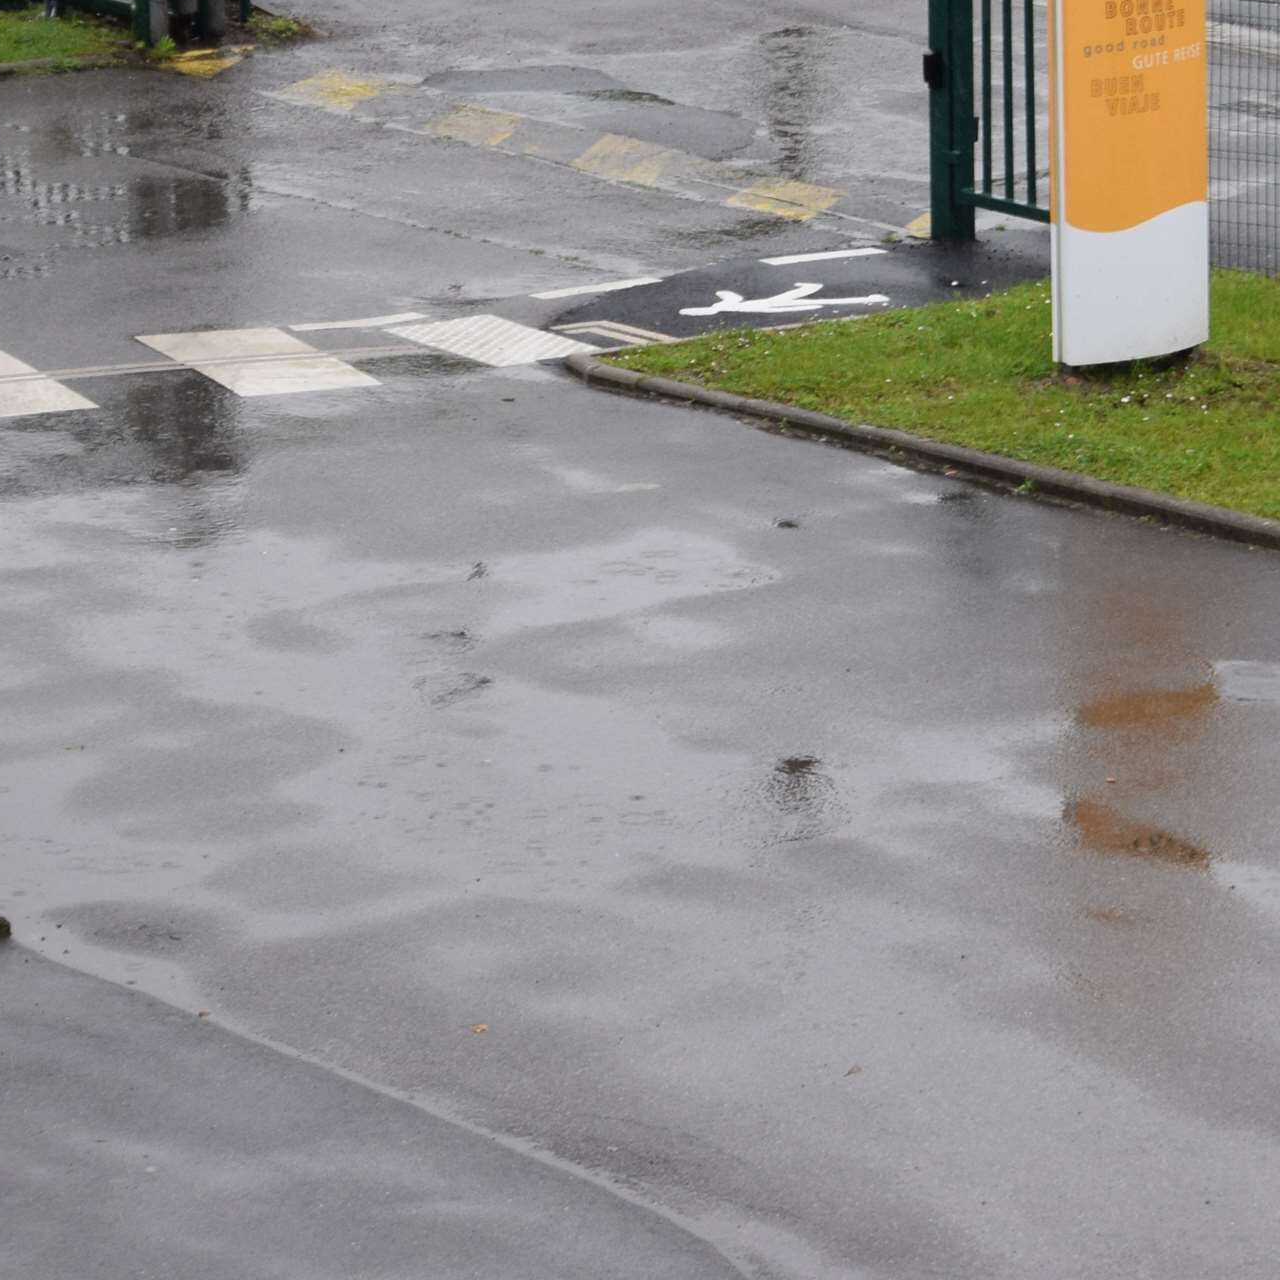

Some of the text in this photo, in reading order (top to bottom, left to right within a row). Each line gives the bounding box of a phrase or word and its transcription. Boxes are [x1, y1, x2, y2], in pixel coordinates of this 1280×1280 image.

[1125, 8, 1185, 36] ROUTE
[1083, 35, 1165, 58] good road
[1132, 43, 1200, 70] GUTE REISE
[1090, 74, 1144, 98] BUEN
[1105, 93, 1160, 116] VIAJE
